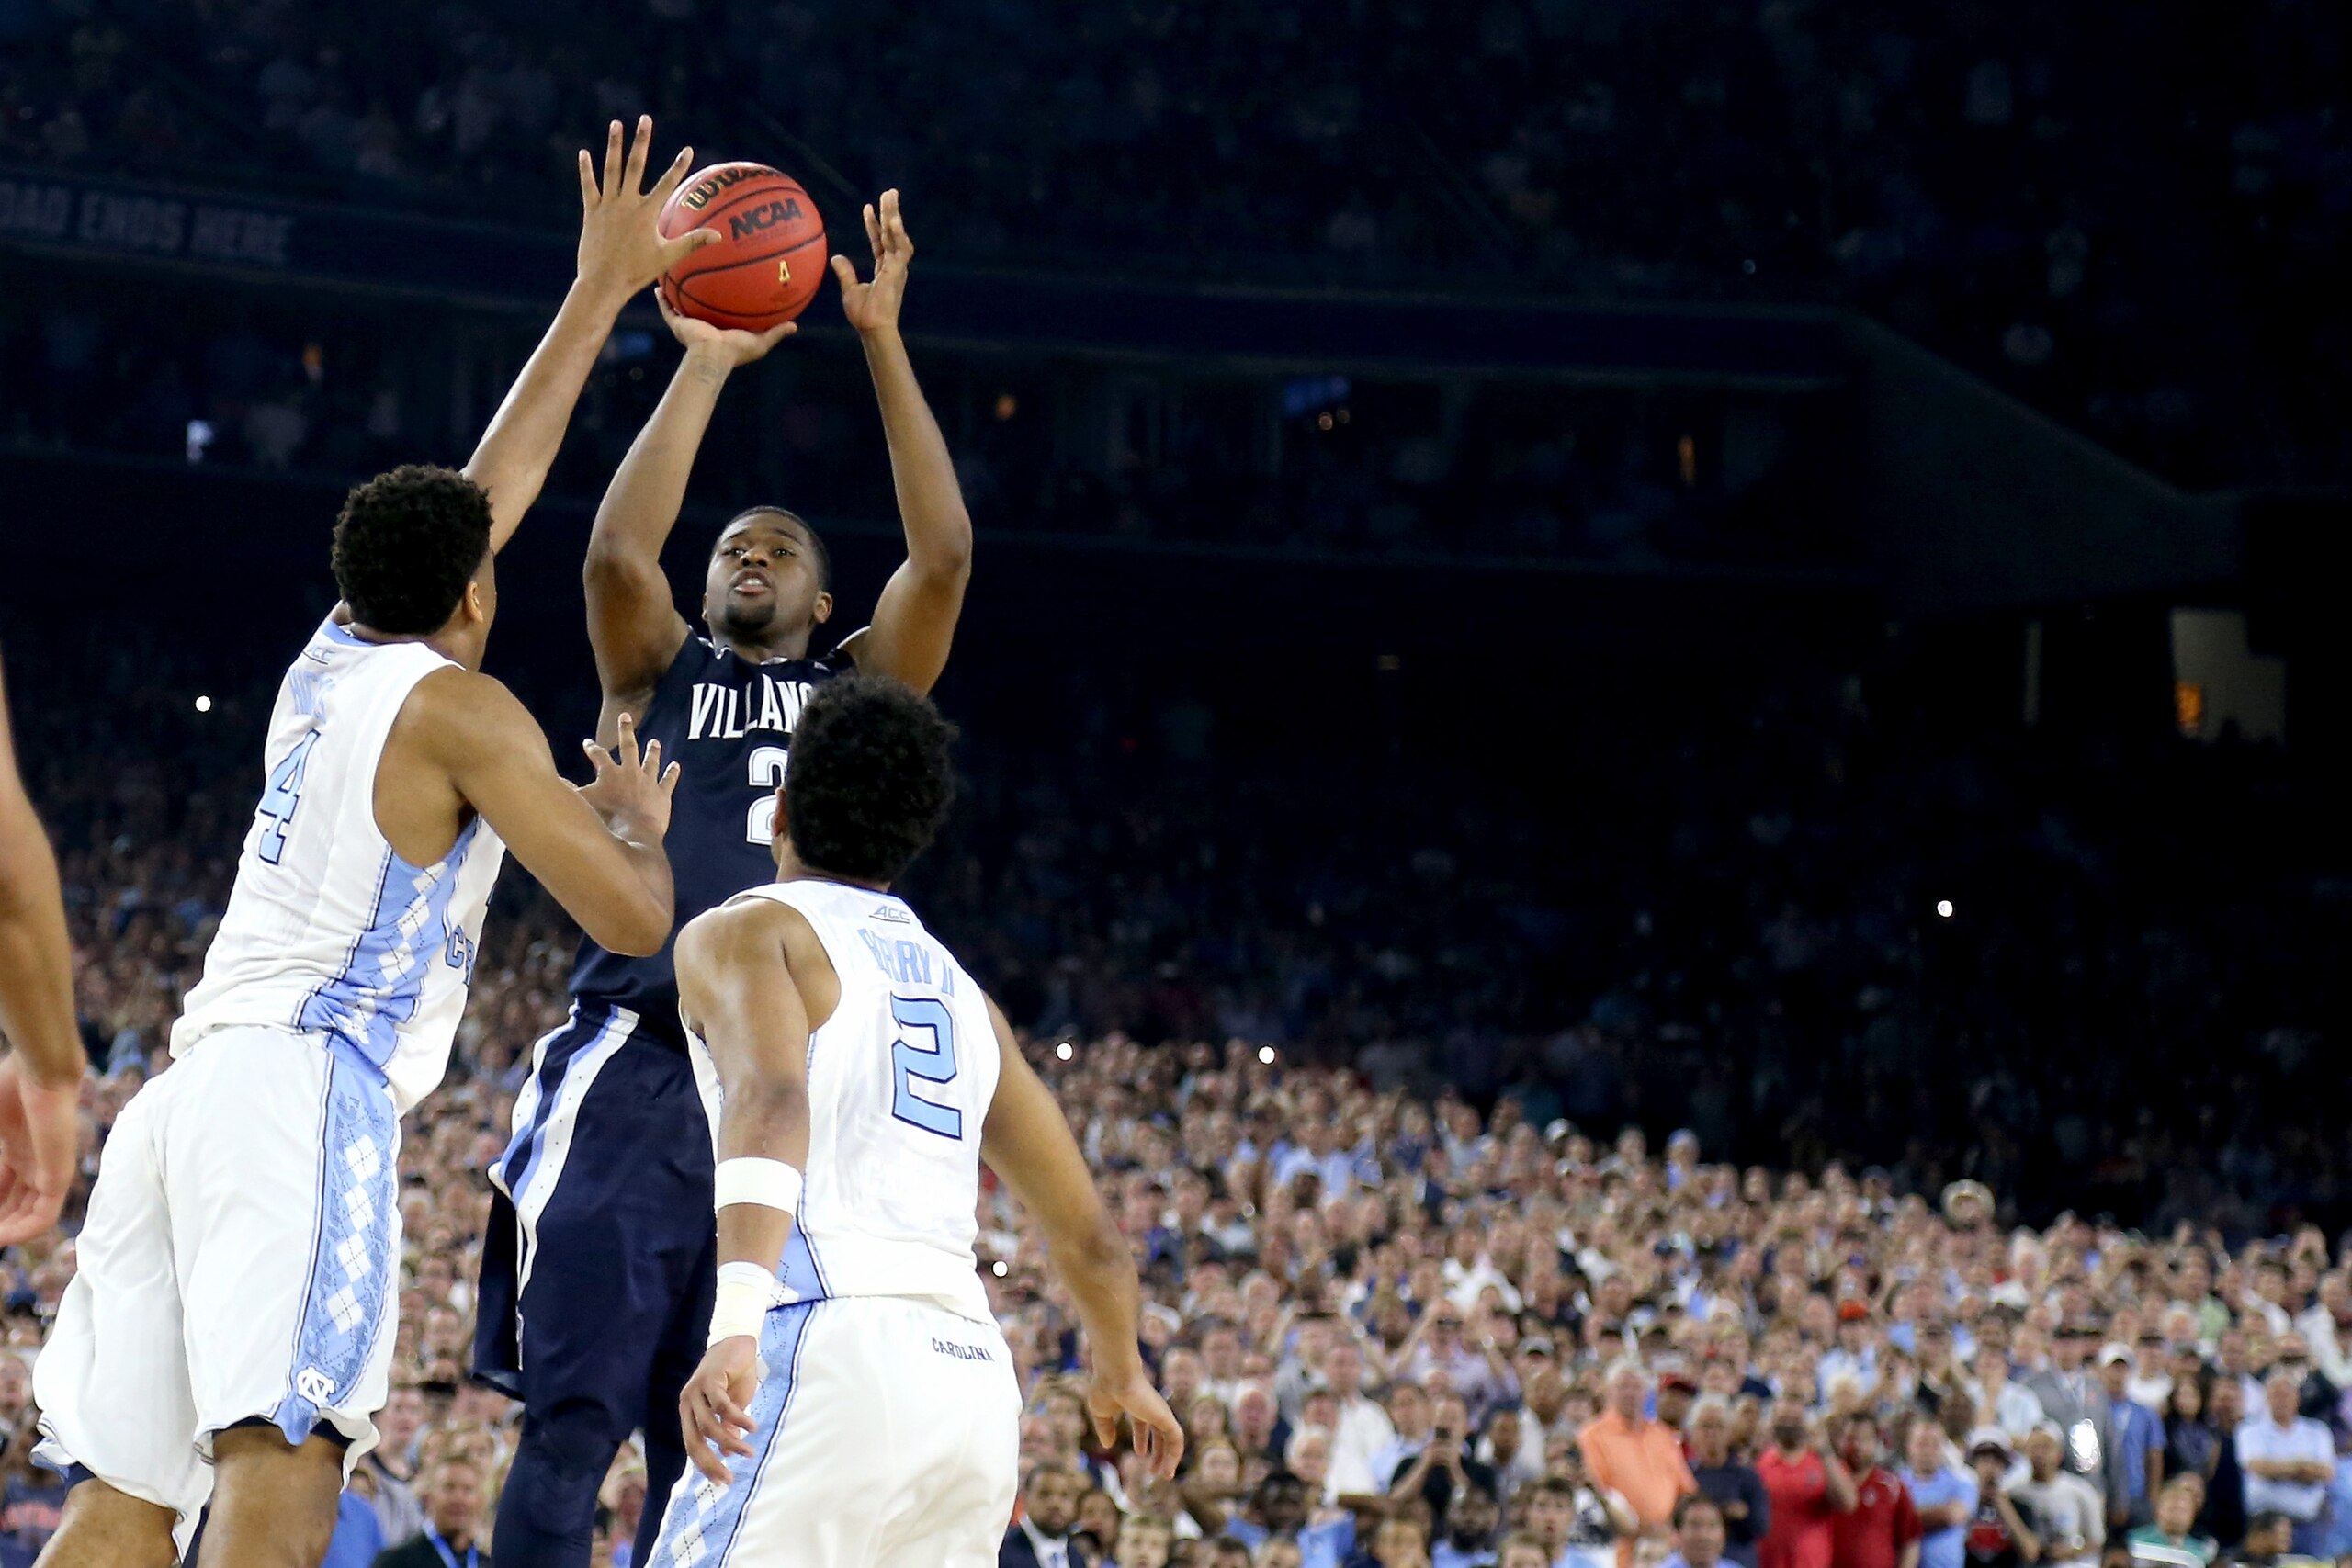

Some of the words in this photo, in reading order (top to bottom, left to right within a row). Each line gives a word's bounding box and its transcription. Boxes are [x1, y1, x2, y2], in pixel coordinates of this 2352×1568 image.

[79, 192, 184, 249] ENDS
[193, 203, 293, 264] HERE
[729, 197, 802, 241] NCAA
[258, 728, 321, 866] 4
[745, 745, 789, 847] 2
[889, 990, 963, 1142] 2
